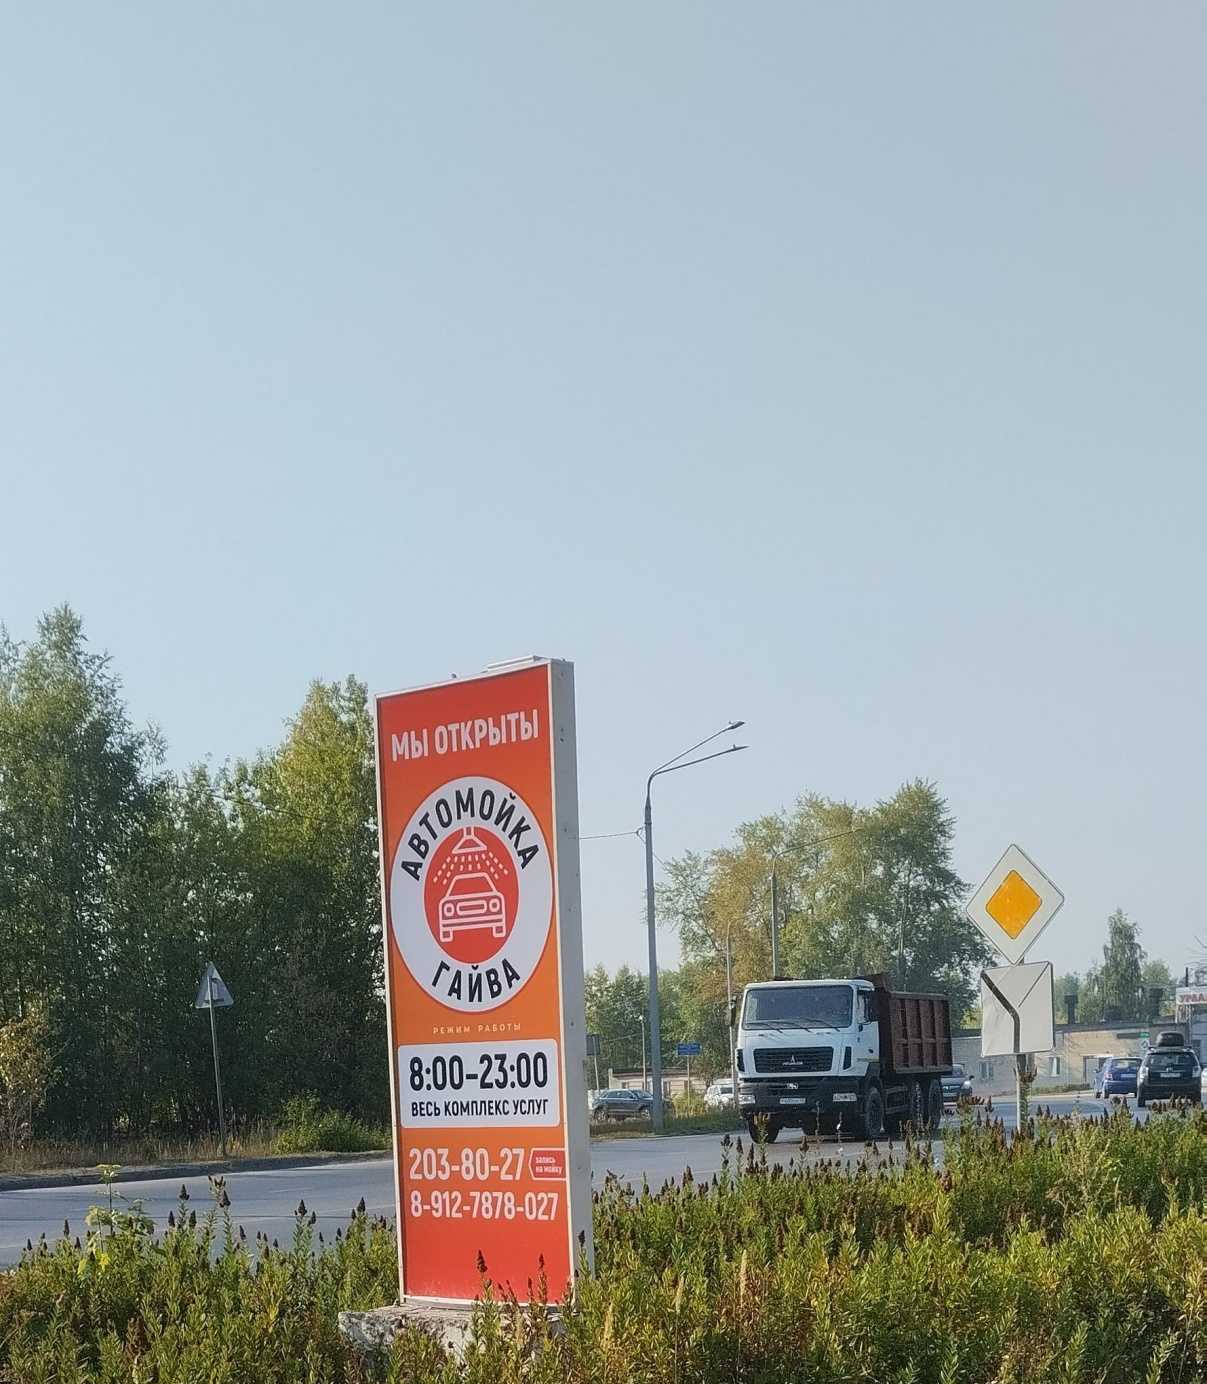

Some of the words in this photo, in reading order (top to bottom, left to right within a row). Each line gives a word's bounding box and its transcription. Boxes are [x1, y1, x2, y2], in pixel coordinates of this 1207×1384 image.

[391, 728, 429, 762] МЫ
[434, 709, 539, 755] ОТКРЫТЫ
[401, 787, 540, 881] АВТОМОЙКА
[431, 958, 521, 1003] ГАЙВА
[432, 1026, 472, 1034] РЕЖИМ
[478, 1023, 521, 1032] РАБОТЫ
[409, 1052, 548, 1091] 8:00-23:00
[411, 1101, 441, 1117] ВЕСЬ
[444, 1100, 510, 1116] КОМПЛЕКС
[513, 1099, 549, 1115] УСЛУГ
[409, 1147, 525, 1181] 203-80-27
[410, 1190, 559, 1221] 8-912-7878-027
